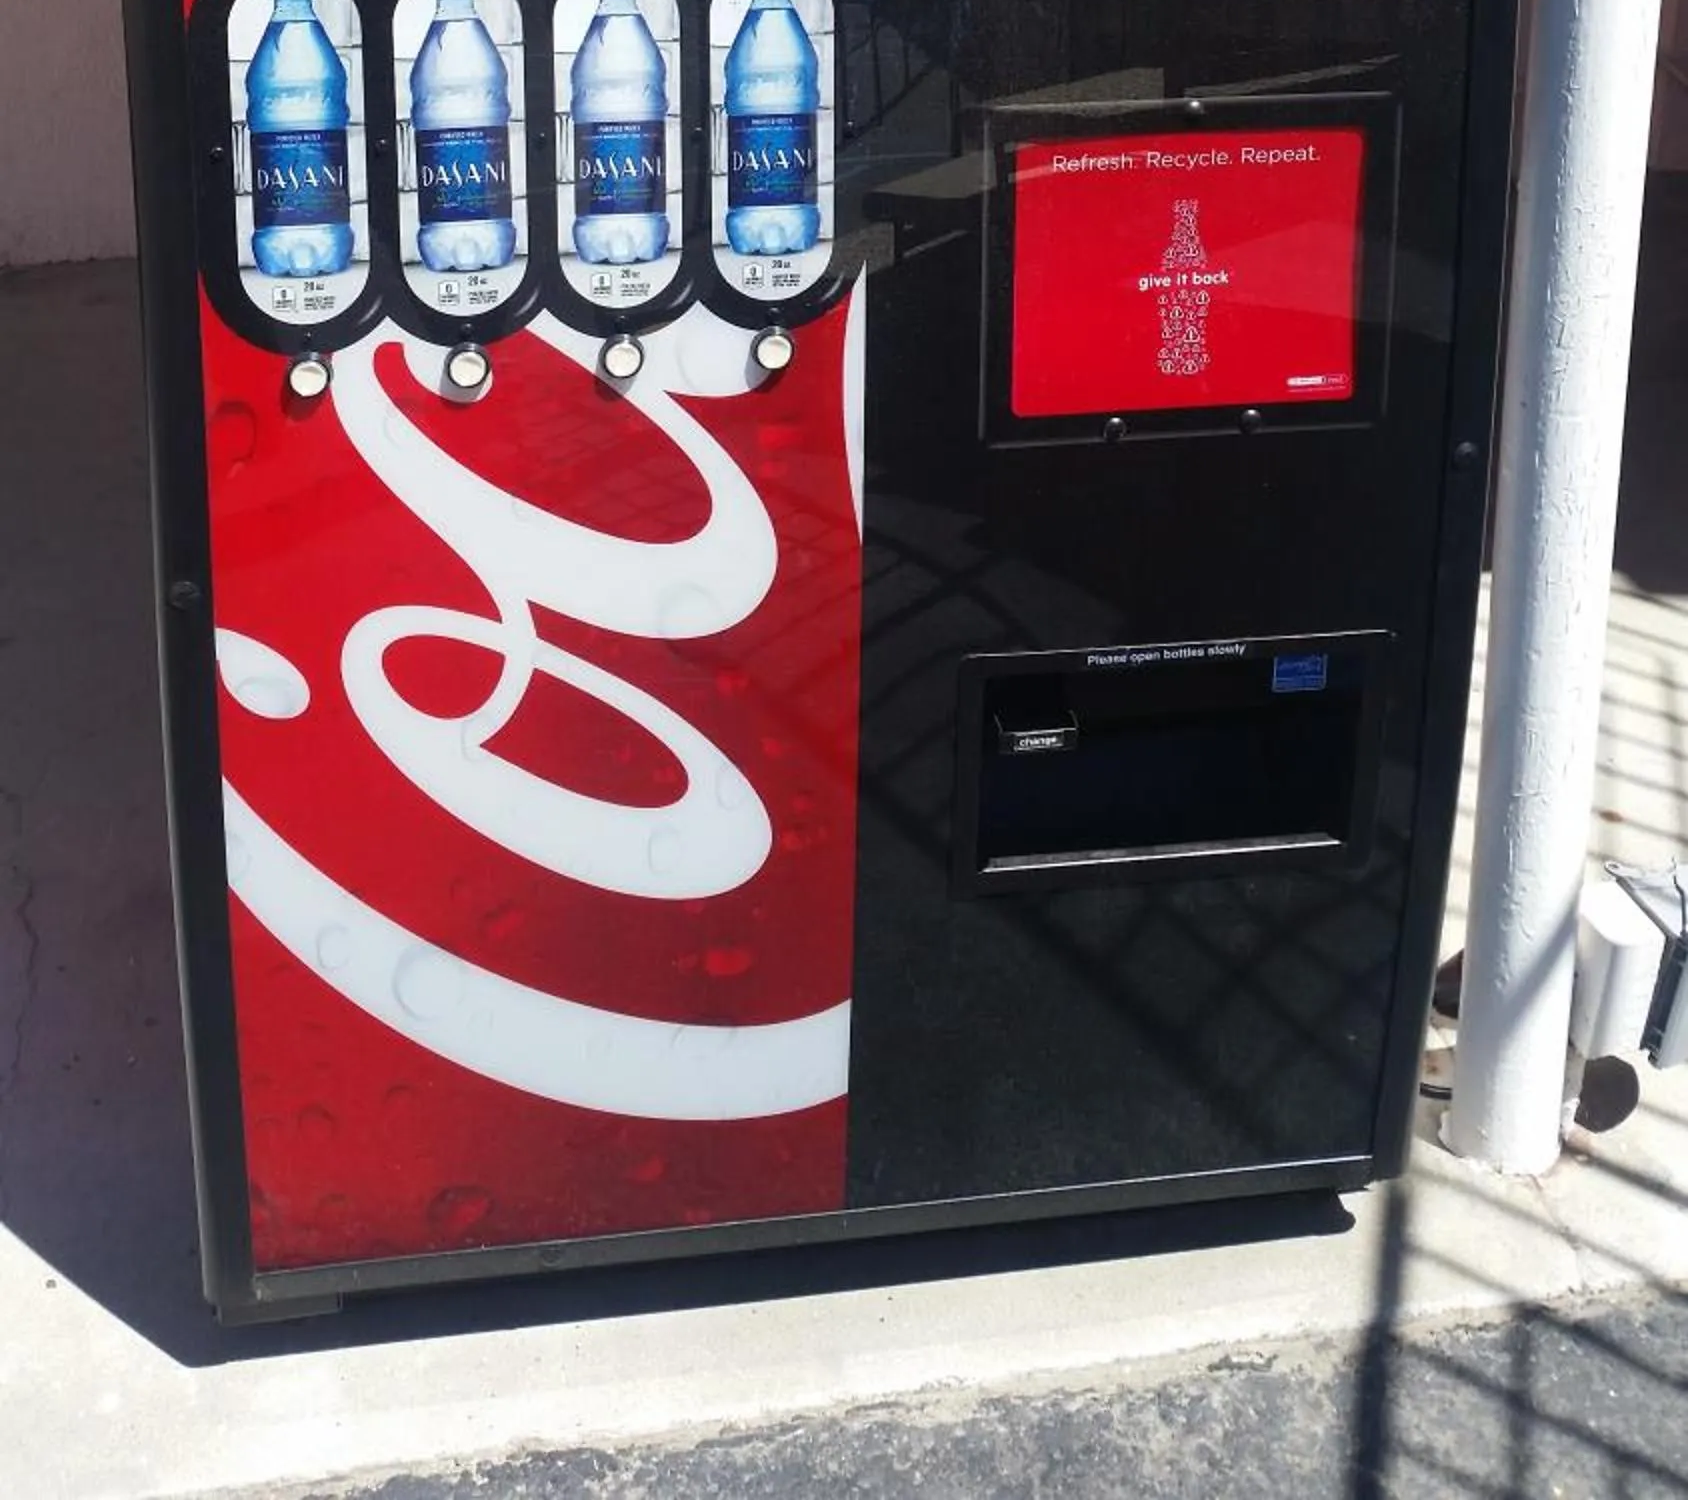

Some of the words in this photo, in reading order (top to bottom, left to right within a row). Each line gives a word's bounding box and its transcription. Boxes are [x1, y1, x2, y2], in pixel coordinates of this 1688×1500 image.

[579, 152, 661, 180] DASANI
[733, 147, 812, 171] DASANI
[1053, 153, 1137, 173] Refresh.
[1147, 150, 1233, 171] Recycle.
[1241, 145, 1321, 166] Repeat.
[257, 164, 343, 192] DASANI
[422, 160, 505, 188] DASANI
[1139, 273, 1171, 292] give
[1176, 272, 1188, 286] it
[1192, 270, 1229, 285] back
[1088, 654, 1127, 666] Please
[1130, 651, 1161, 665] open
[1163, 648, 1205, 660] bottles
[1207, 644, 1247, 657] slowly
[1019, 736, 1057, 749] change
